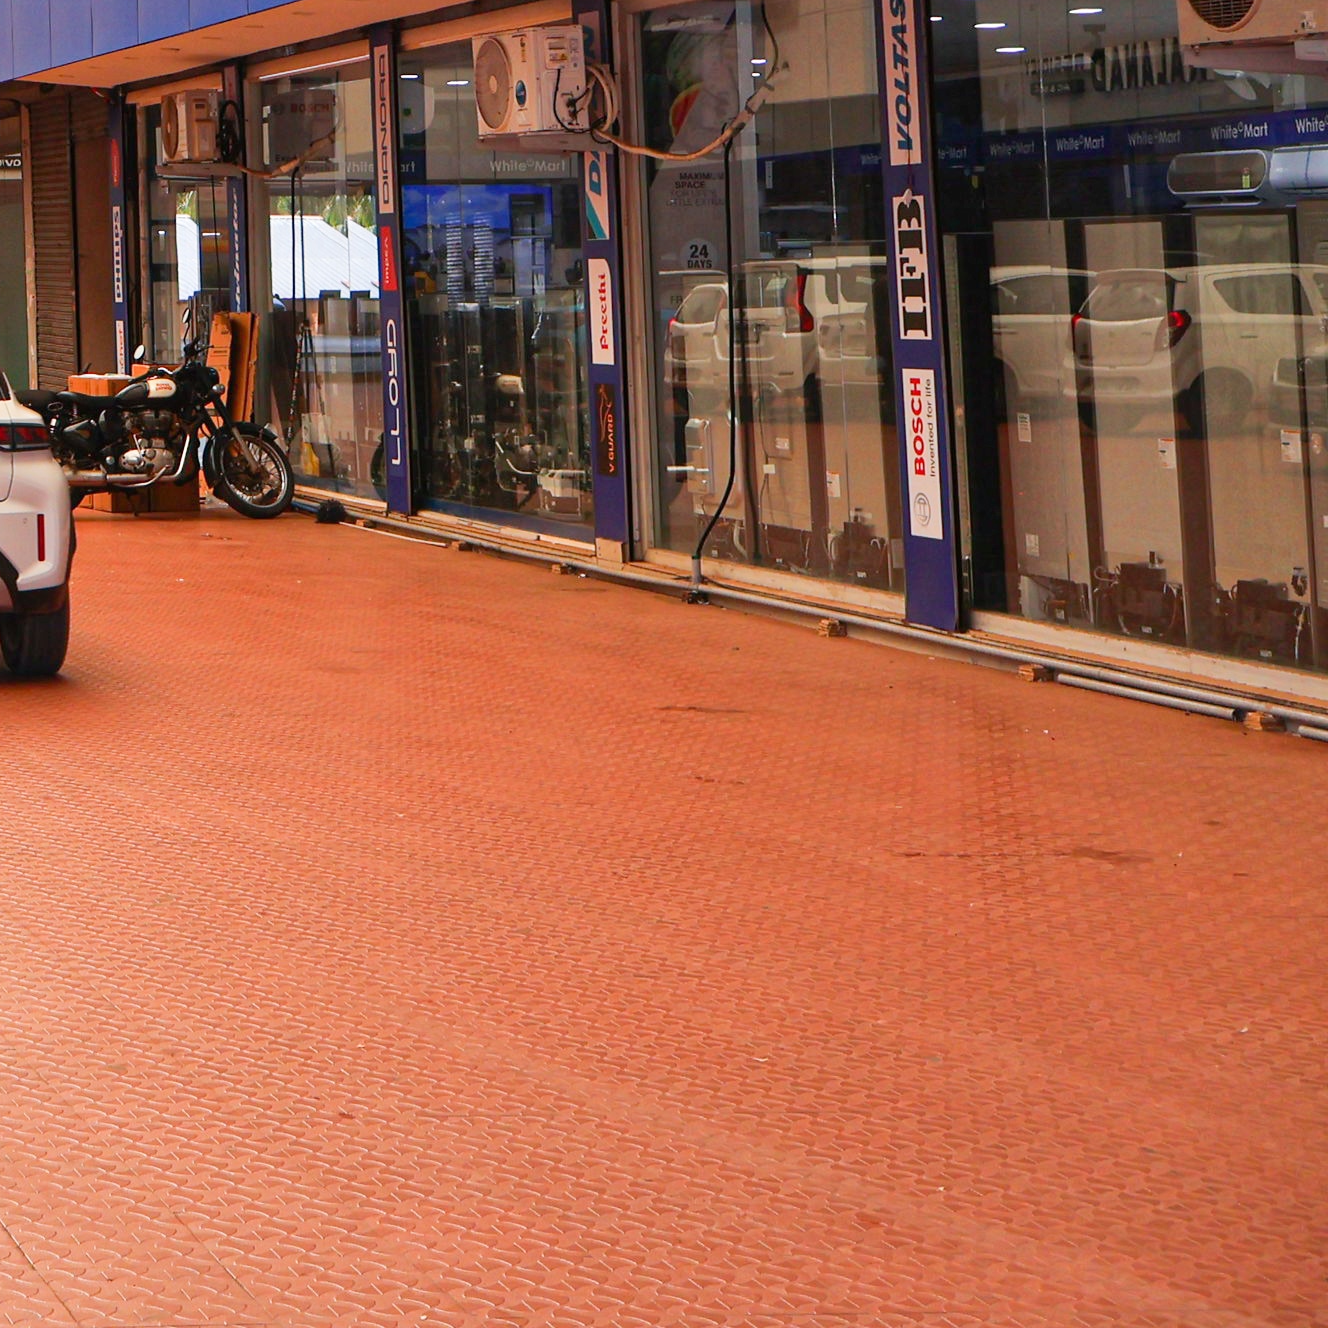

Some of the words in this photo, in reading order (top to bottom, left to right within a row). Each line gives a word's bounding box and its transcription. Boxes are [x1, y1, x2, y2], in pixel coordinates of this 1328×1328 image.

[378, 54, 390, 204] DIANORA
[687, 260, 712, 269] DAYS
[689, 244, 709, 259] 24
[897, 200, 928, 337] IFB
[597, 272, 609, 351] Preethi
[386, 319, 401, 465] LLOYD
[909, 377, 926, 477] BOSCH
[606, 413, 615, 461] GUARD
[927, 422, 936, 477] Invented
